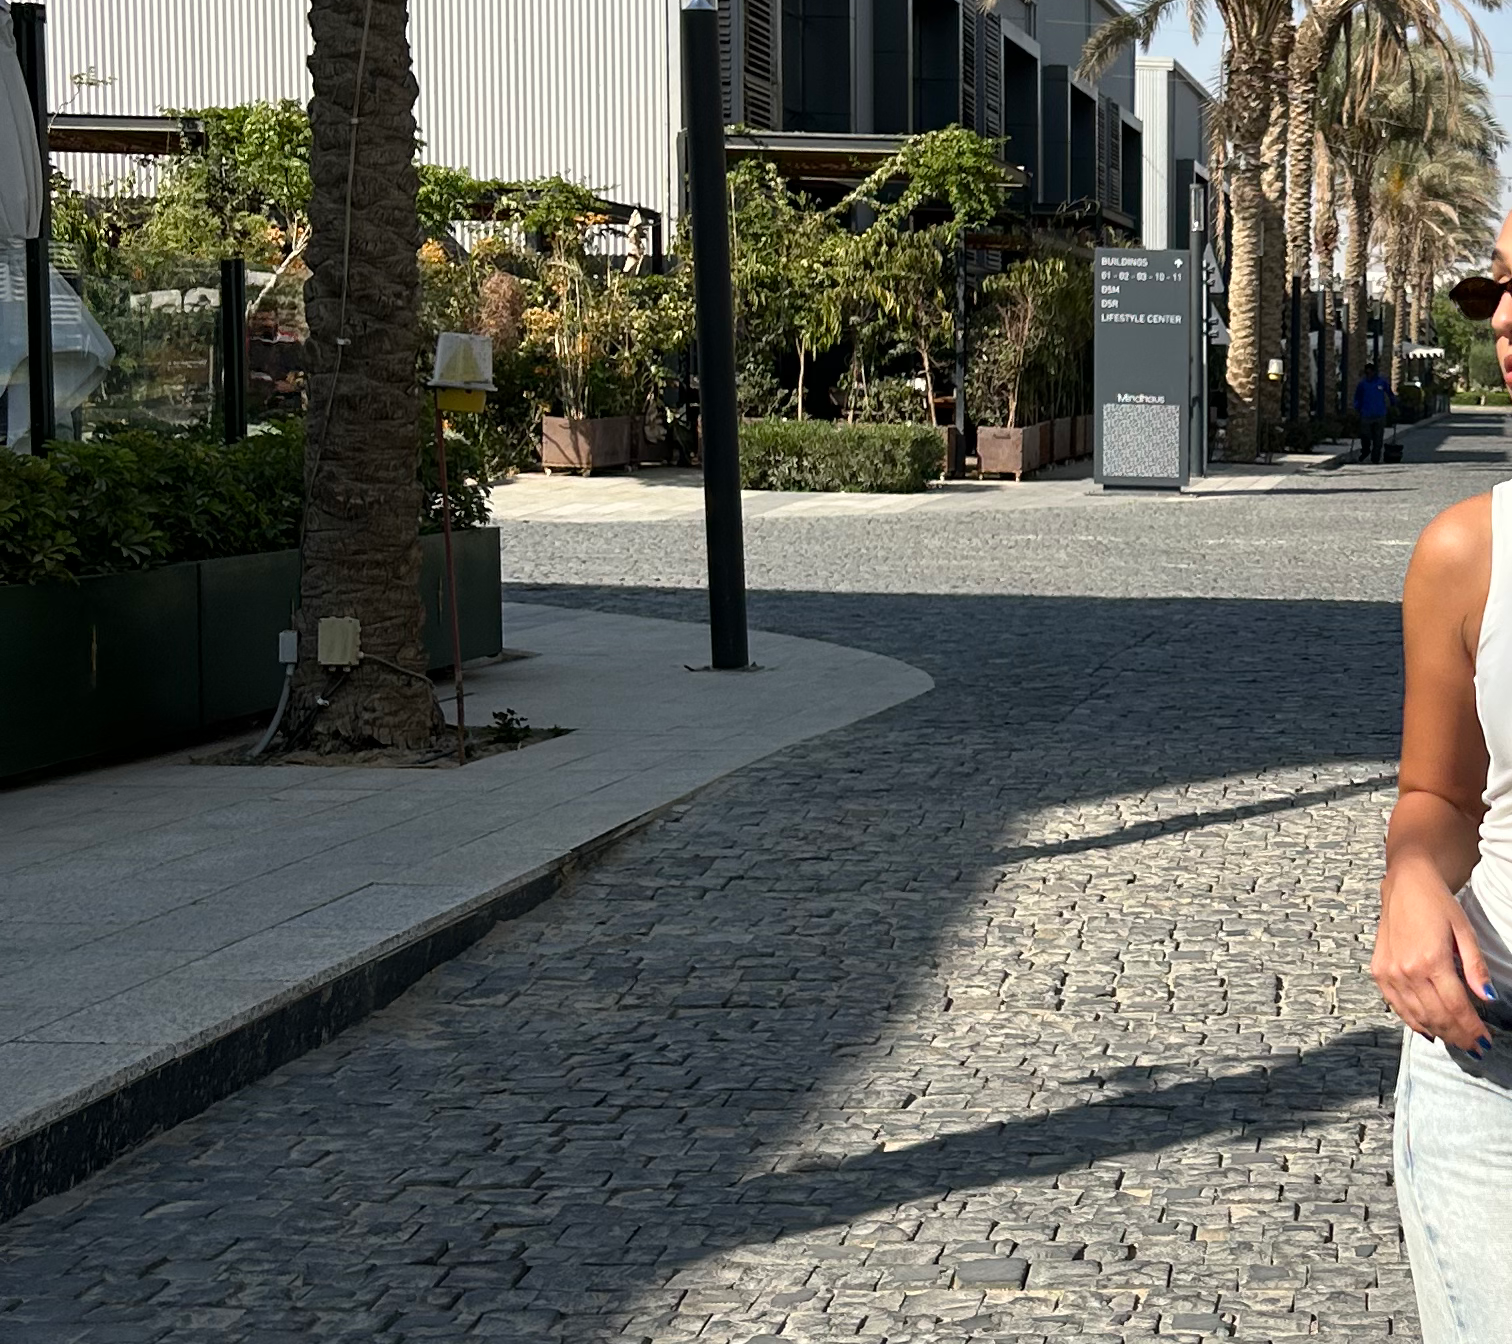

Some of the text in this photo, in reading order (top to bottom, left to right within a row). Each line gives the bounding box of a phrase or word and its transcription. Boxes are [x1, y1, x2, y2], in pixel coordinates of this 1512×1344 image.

[1101, 256, 1149, 267] BUILDINGS
[1101, 312, 1182, 325] LIFESTYLE CENTER
[1117, 392, 1166, 404] Mindhaus
